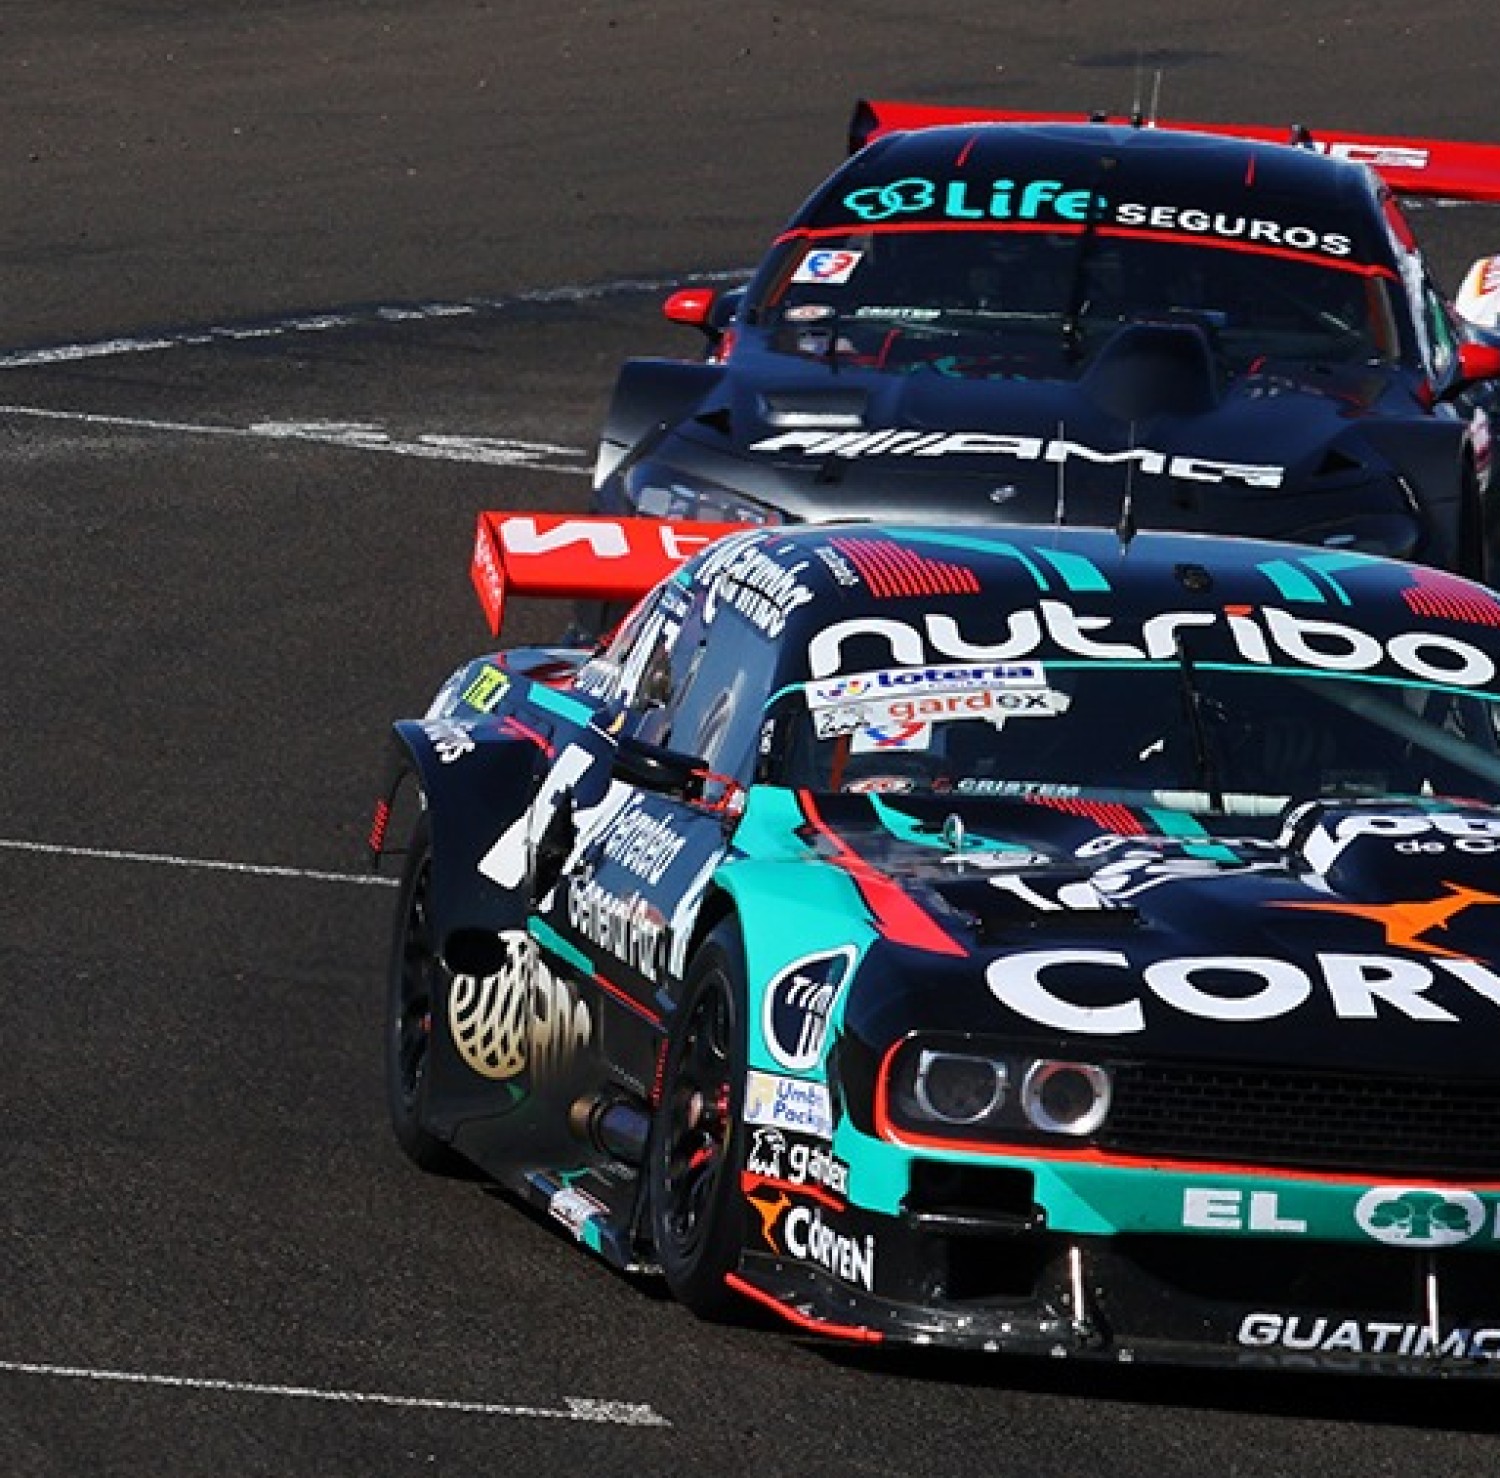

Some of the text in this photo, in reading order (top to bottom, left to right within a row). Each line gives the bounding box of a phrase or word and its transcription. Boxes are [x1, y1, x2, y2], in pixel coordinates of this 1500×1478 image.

[946, 180, 1352, 256] Life SEGUROS
[1182, 1187, 1307, 1232] EL
[785, 1206, 875, 1292] CORVEN
